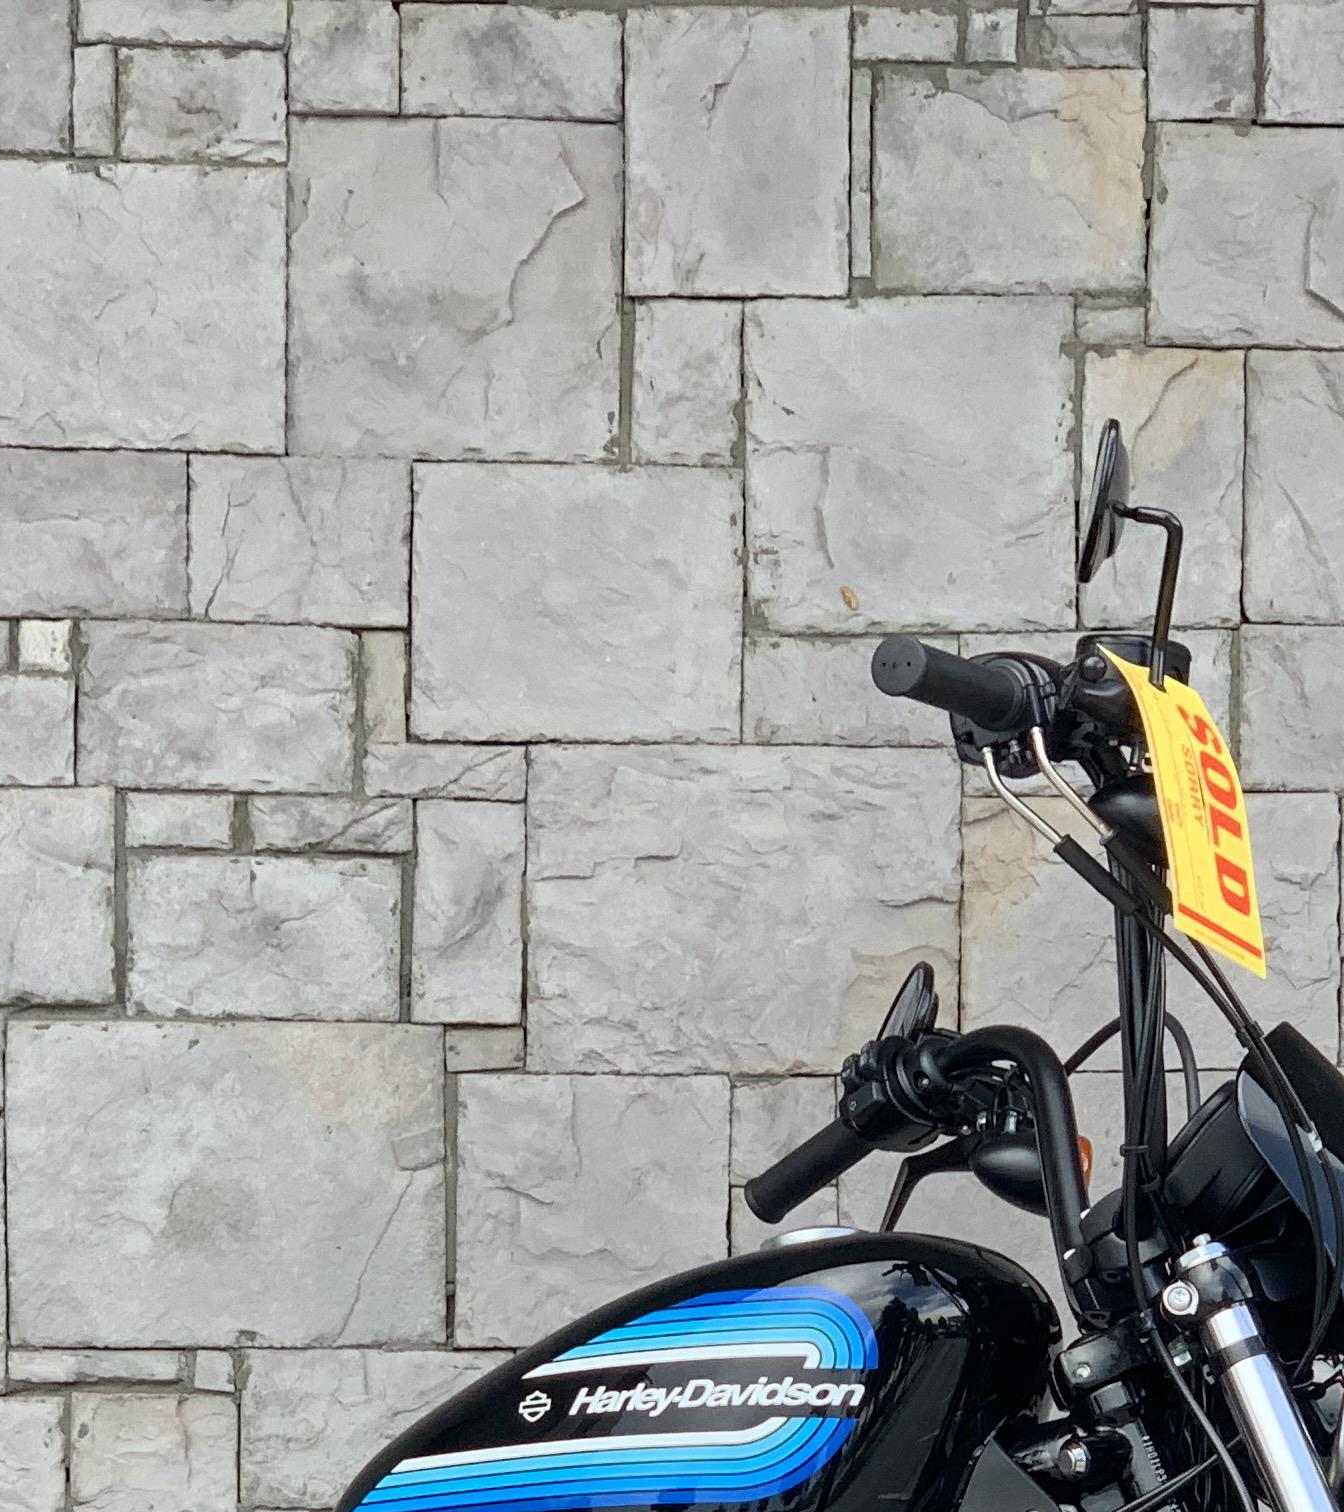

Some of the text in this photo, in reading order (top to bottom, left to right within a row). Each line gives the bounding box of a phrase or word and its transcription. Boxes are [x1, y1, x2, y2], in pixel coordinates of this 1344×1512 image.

[1177, 704, 1250, 916] SOLD
[1183, 745, 1204, 829] SORRY
[568, 1376, 866, 1417] Harley-Davidson
